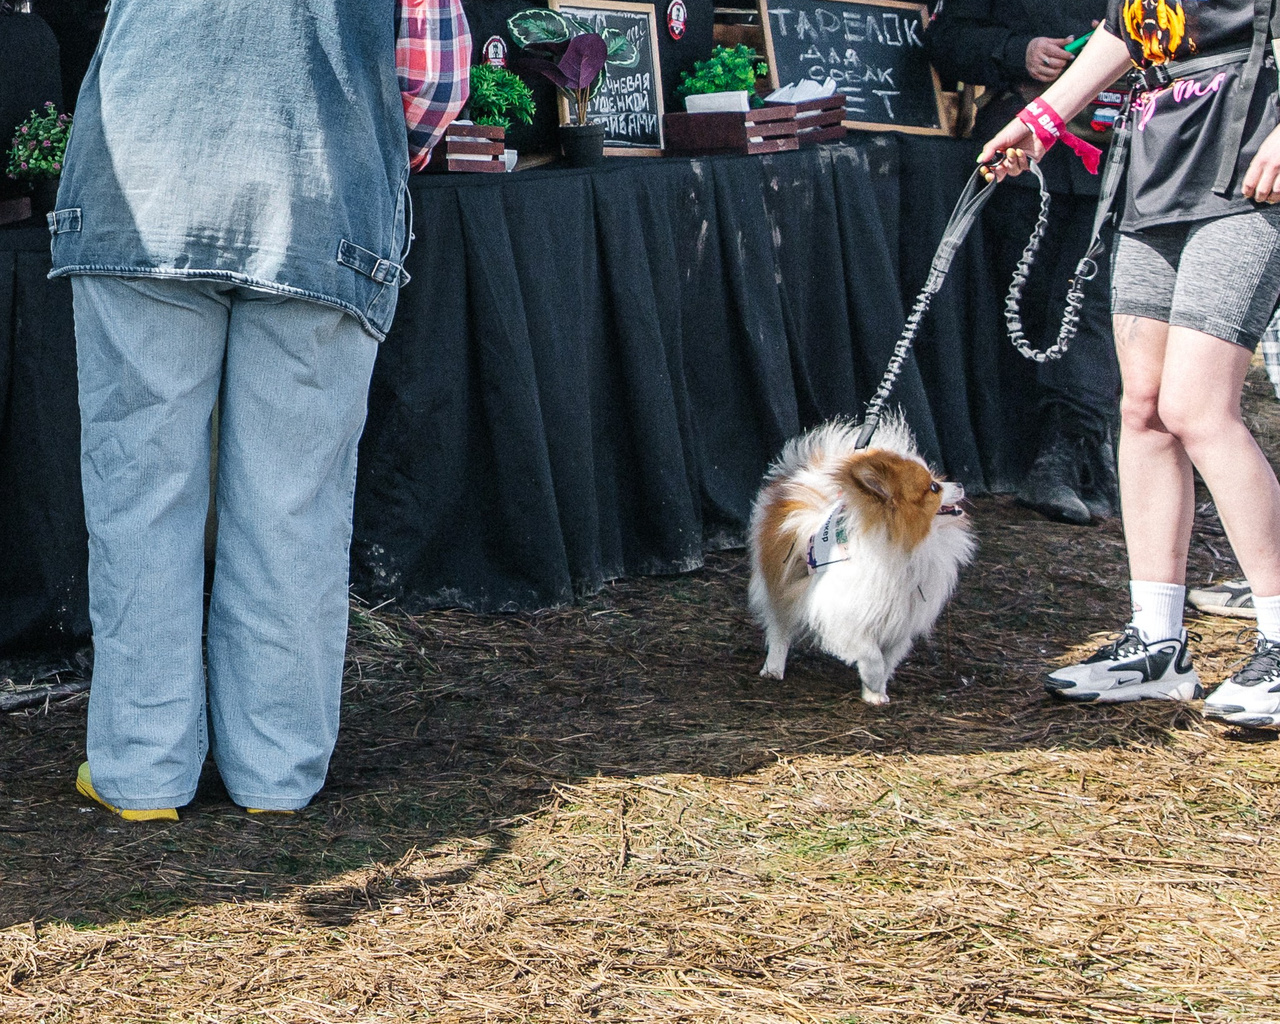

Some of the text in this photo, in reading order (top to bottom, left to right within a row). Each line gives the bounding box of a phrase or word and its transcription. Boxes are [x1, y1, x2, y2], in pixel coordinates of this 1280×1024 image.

[767, 8, 923, 47] ТАРЕЛОК
[808, 64, 895, 89] СОБАК
[835, 86, 901, 120] ЕТ
